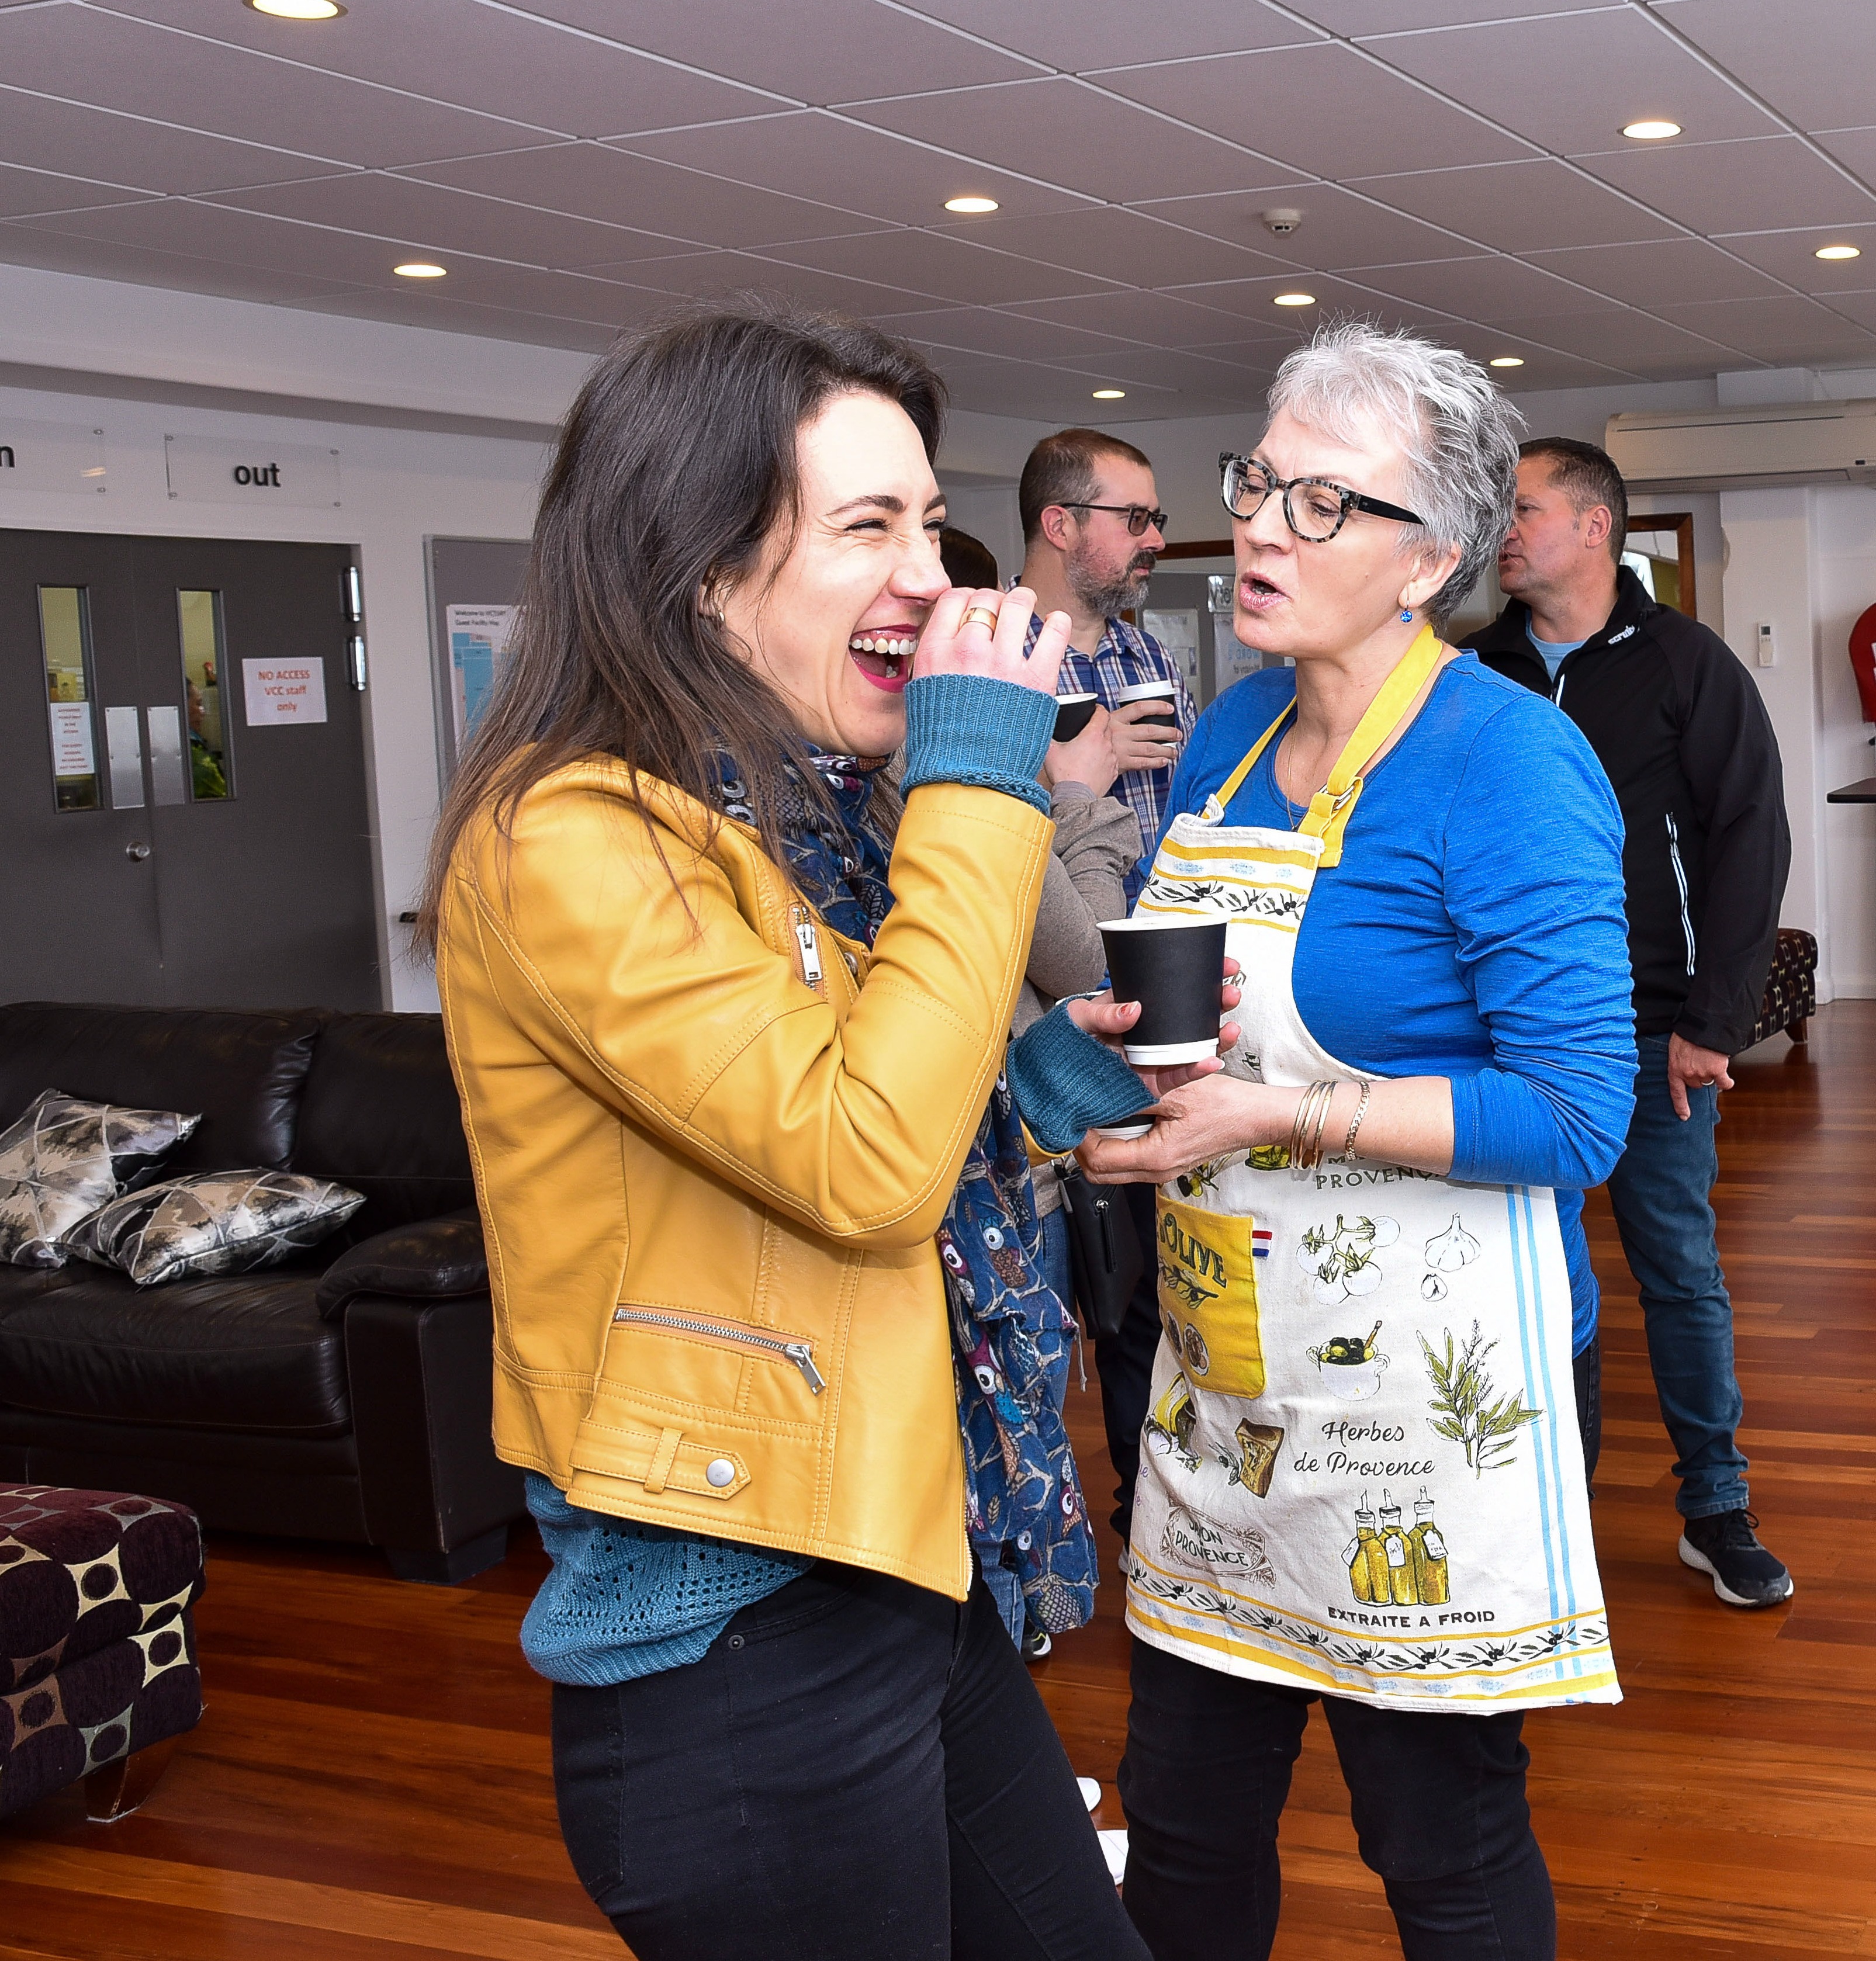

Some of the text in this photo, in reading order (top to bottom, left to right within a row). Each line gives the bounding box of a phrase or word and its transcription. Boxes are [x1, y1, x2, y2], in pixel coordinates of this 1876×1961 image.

[0, 446, 15, 467] n
[234, 463, 281, 487] out
[258, 670, 310, 680] NO ACCESS
[265, 685, 307, 695] VCC staff
[276, 702, 297, 712] only
[1316, 1167, 1439, 1190] PROVENÇ
[1321, 1420, 1404, 1447] Herbes
[1293, 1451, 1320, 1471] de
[1327, 1451, 1435, 1476] Provence
[1175, 1530, 1249, 1567] PROVENCE
[1327, 1606, 1495, 1627] EXTRAITE A FROID
